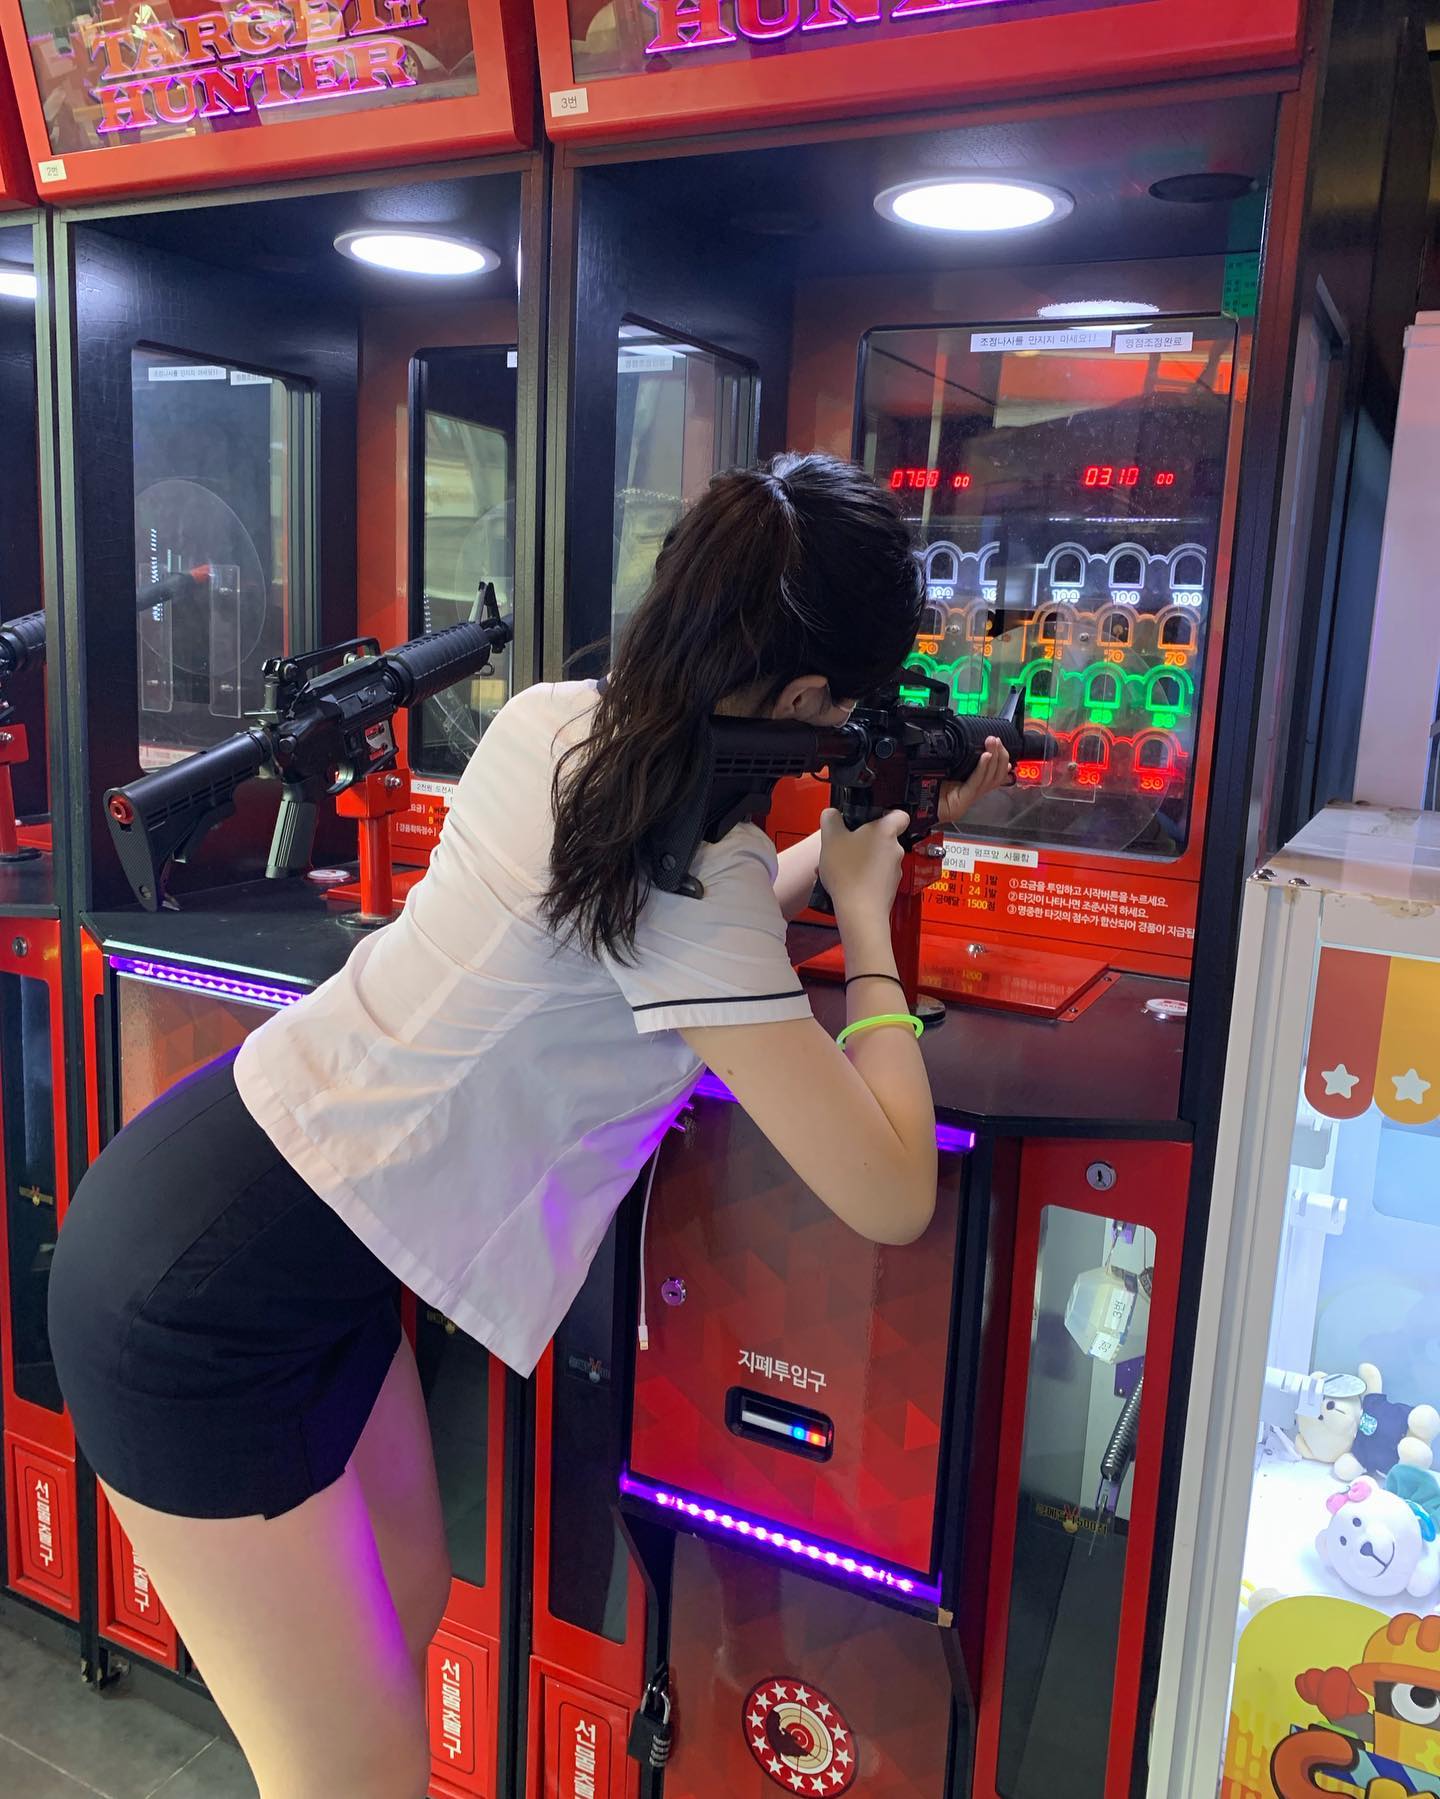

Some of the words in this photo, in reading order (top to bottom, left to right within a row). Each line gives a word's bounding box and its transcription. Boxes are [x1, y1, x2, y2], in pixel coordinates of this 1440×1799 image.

[644, 0, 1000, 53] HUN
[91, 38, 417, 132] HUNTER
[561, 96, 577, 109] 3번
[1085, 467, 1139, 486] 0310
[982, 587, 997, 602] 10
[1052, 589, 1080, 603] 100
[1111, 590, 1140, 605] 100
[1172, 592, 1202, 607] 100
[918, 641, 939, 655] 70
[1165, 650, 1187, 666] 70
[408, 803, 426, 814] 요금]
[969, 873, 981, 883] 18
[968, 886, 981, 897] 24
[1020, 880, 1046, 893] 요금을
[1047, 882, 1082, 897] 투입하고
[1083, 887, 1128, 904] 시작버튼을
[1129, 893, 1169, 908] 누르세요.
[967, 899, 996, 912] 1500점
[1018, 892, 1044, 906] 타깃이
[1045, 896, 1081, 911] 나타나면
[1081, 900, 1118, 916] 조준사격
[1119, 905, 1149, 919] 하세요.
[1017, 905, 1043, 919] 명중한
[1044, 909, 1071, 923] 타깃의
[1072, 912, 1099, 927] 점수가
[1100, 916, 1136, 931] 합산되어
[1138, 921, 1165, 936] 경품이
[737, 1348, 828, 1394] 지폐투입구
[573, 1719, 597, 1799] 선물출
